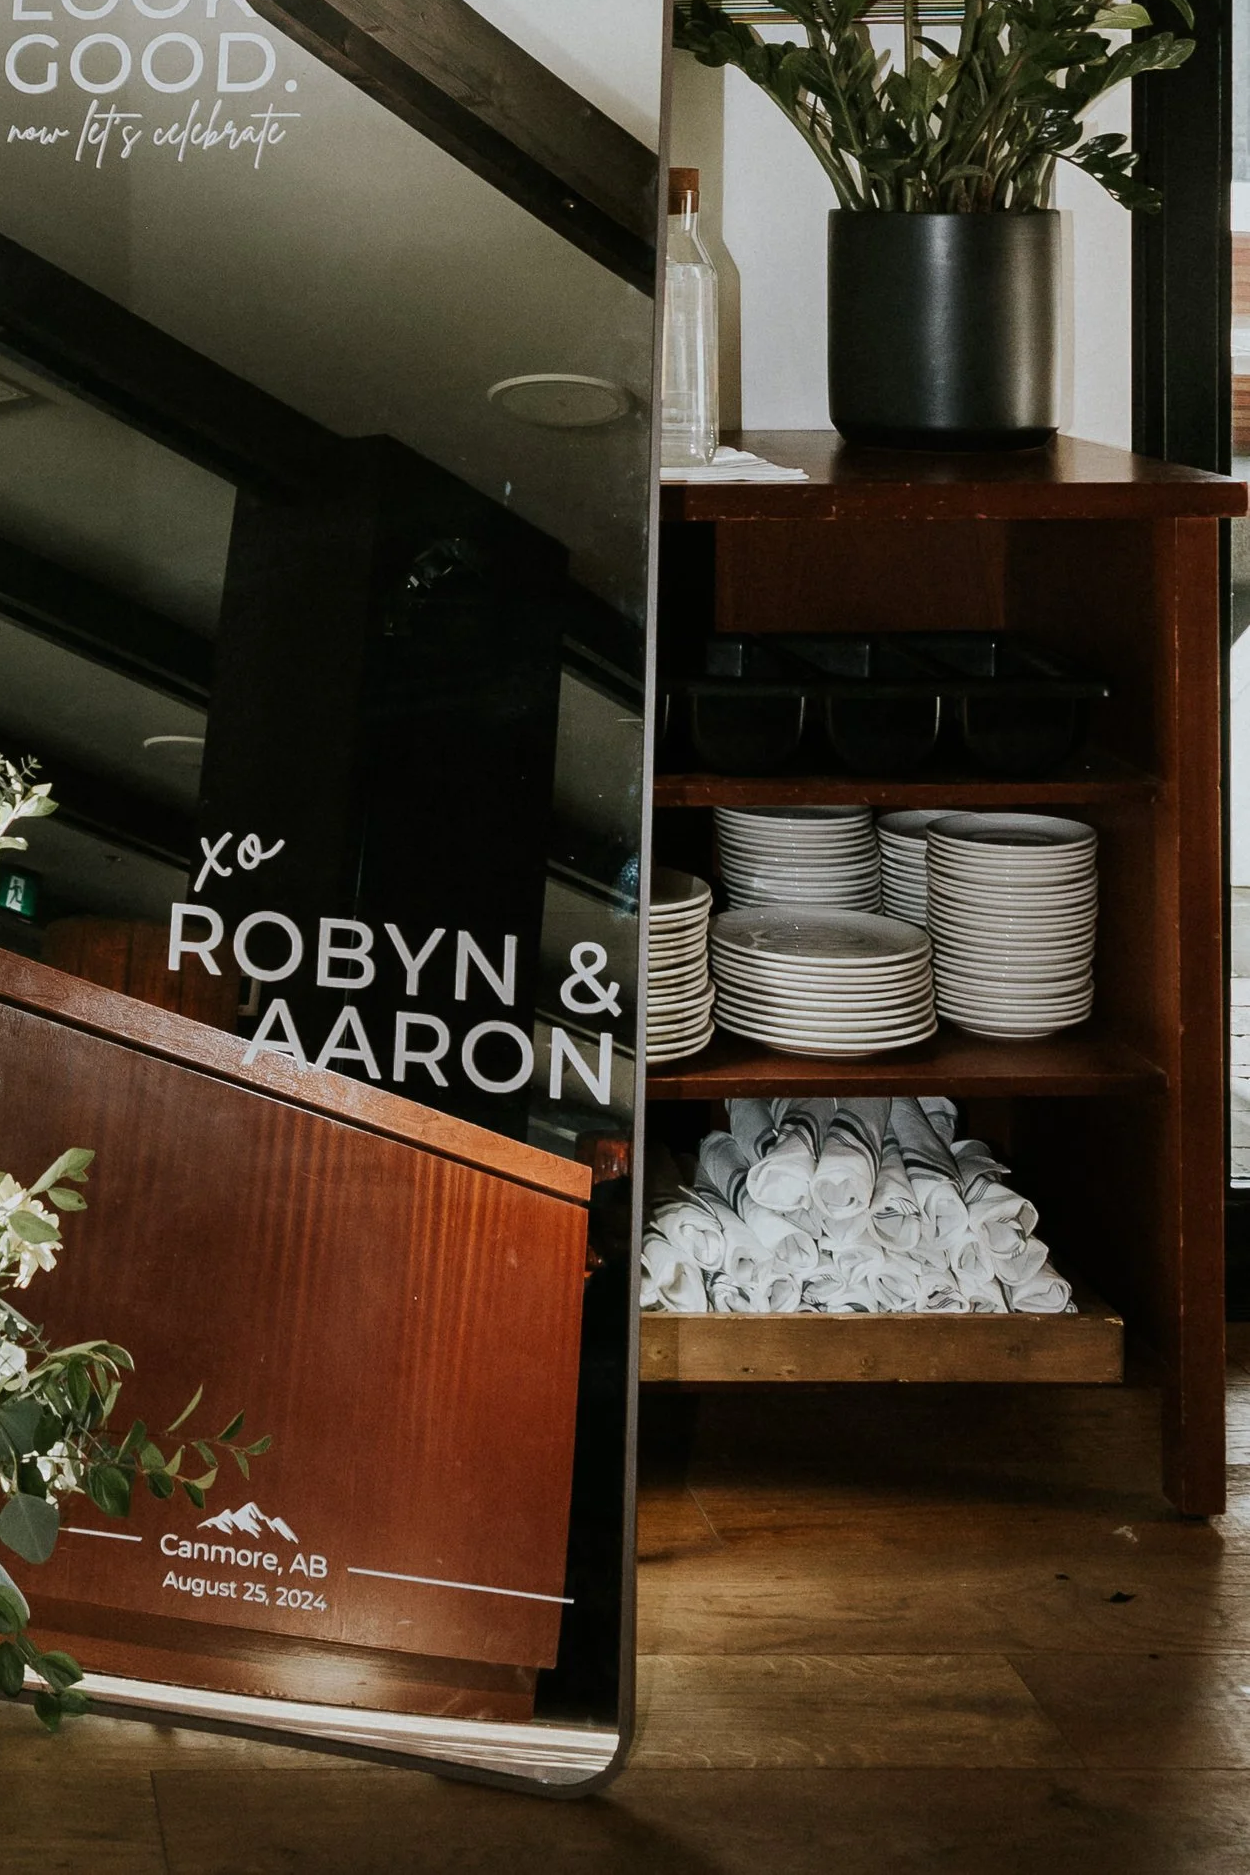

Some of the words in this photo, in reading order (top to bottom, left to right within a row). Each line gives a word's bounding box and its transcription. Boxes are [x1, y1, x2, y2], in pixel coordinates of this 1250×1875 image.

[4, 32, 298, 94] GOOD.
[7, 123, 69, 144] now
[75, 99, 143, 169] let's
[153, 99, 301, 169] celebrate
[193, 831, 285, 893] xo
[168, 902, 517, 1007] ROBYN
[560, 941, 623, 1018] &
[241, 998, 613, 1106] AARON
[160, 1533, 283, 1576] Canmore,
[289, 1553, 328, 1578] AB
[162, 1570, 237, 1597] August
[242, 1581, 270, 1605] 25,
[275, 1587, 327, 1612] 2024
